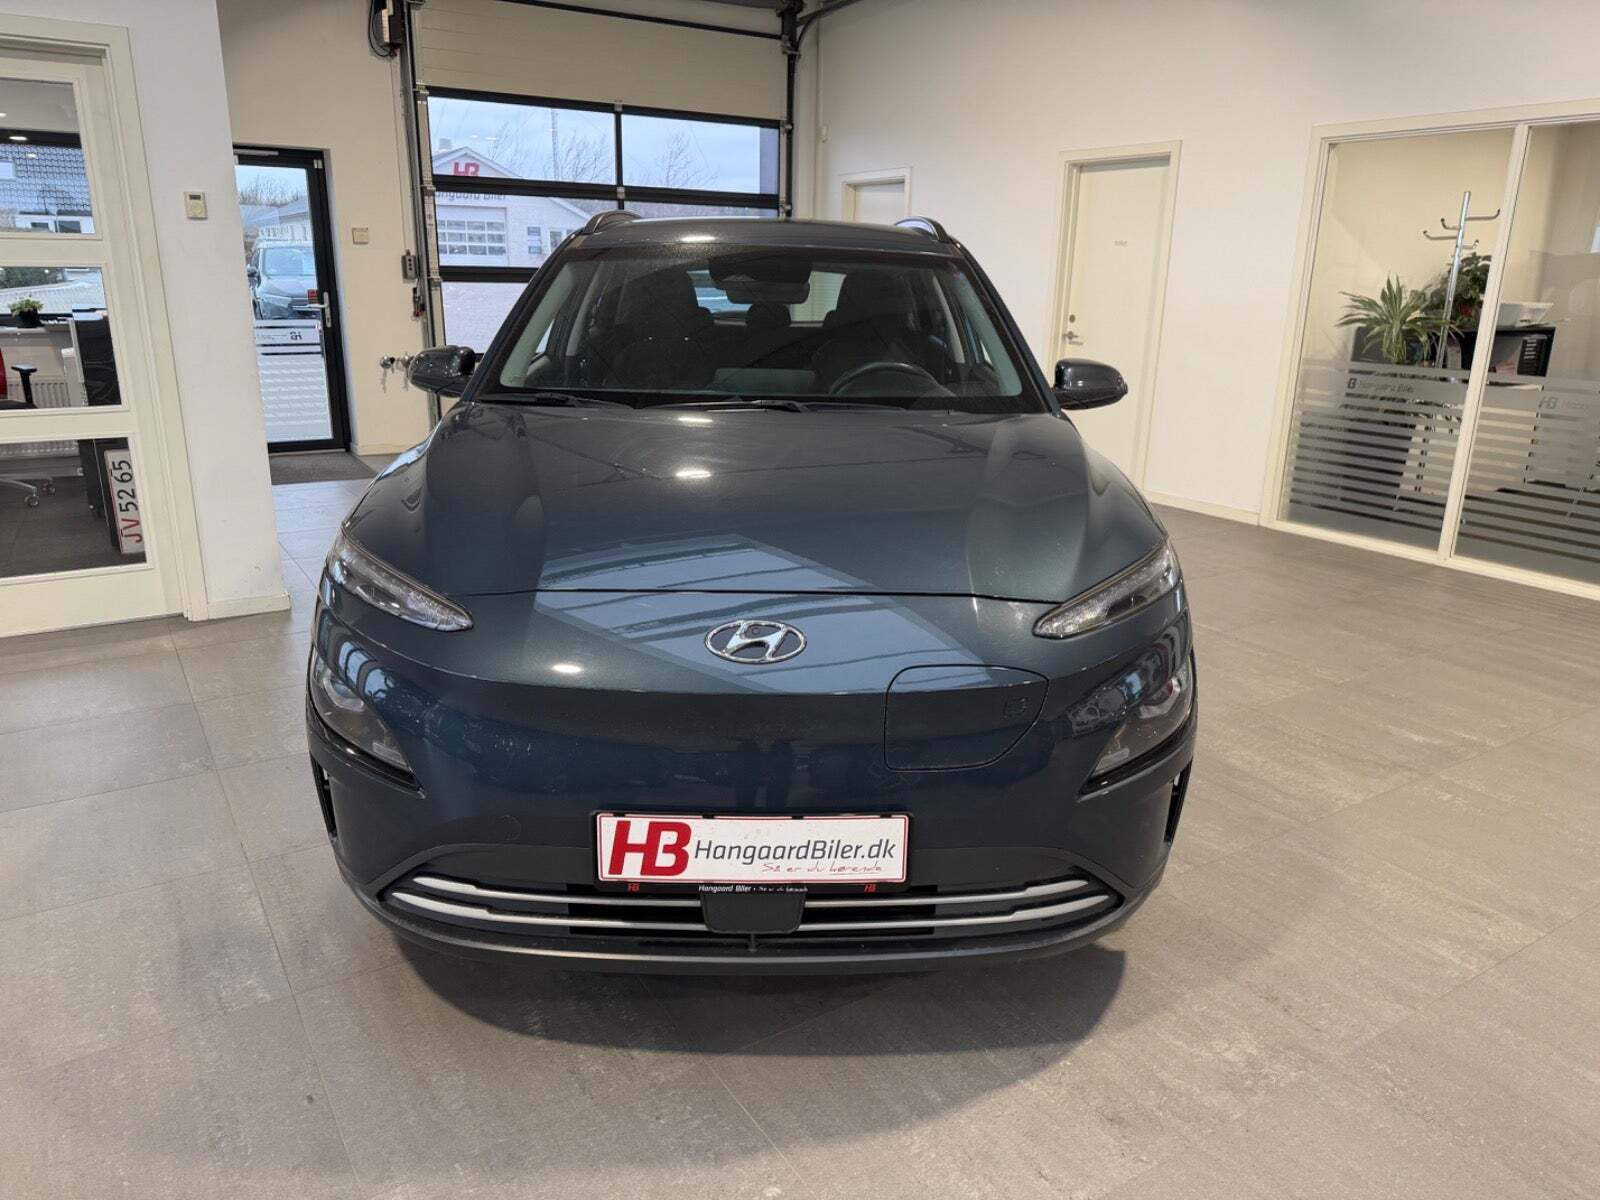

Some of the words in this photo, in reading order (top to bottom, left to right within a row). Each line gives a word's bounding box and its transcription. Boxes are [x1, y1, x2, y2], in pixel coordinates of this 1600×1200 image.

[121, 518, 143, 543] JV
[608, 820, 692, 877] HB
[694, 838, 896, 866] HangaardBiler.dk
